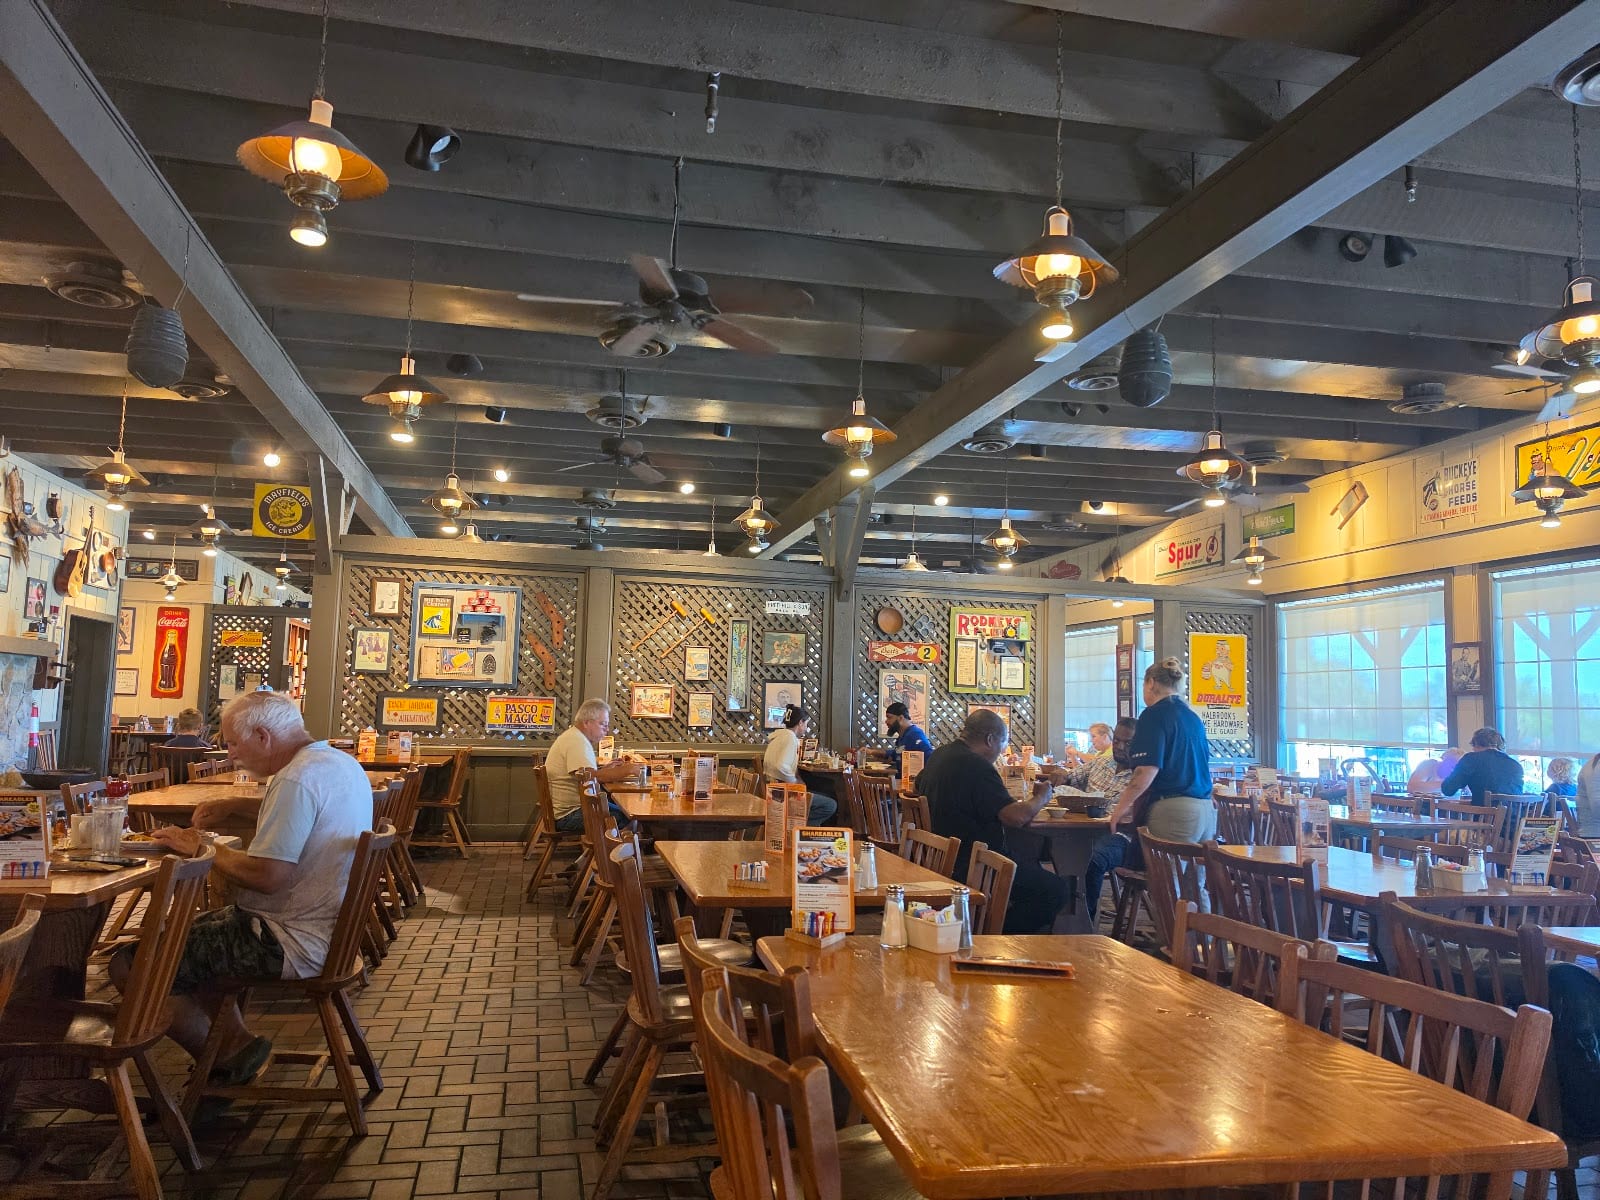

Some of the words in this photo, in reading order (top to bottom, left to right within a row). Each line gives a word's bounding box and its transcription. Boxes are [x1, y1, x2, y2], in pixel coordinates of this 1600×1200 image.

[1443, 460, 1477, 481] BUCKEYE
[1447, 480, 1476, 495] HORSE
[263, 488, 310, 508] MAYFIELD'S
[1448, 492, 1478, 508] FEEDS
[265, 521, 277, 532] ICE
[278, 523, 304, 535] CREAM
[1168, 542, 1202, 569] Spur
[158, 617, 188, 628] Coca-Cola
[923, 647, 931, 660] 2
[504, 703, 538, 714] PASCO
[504, 713, 538, 724] MAGIC
[1213, 720, 1244, 729] HARDWARE
